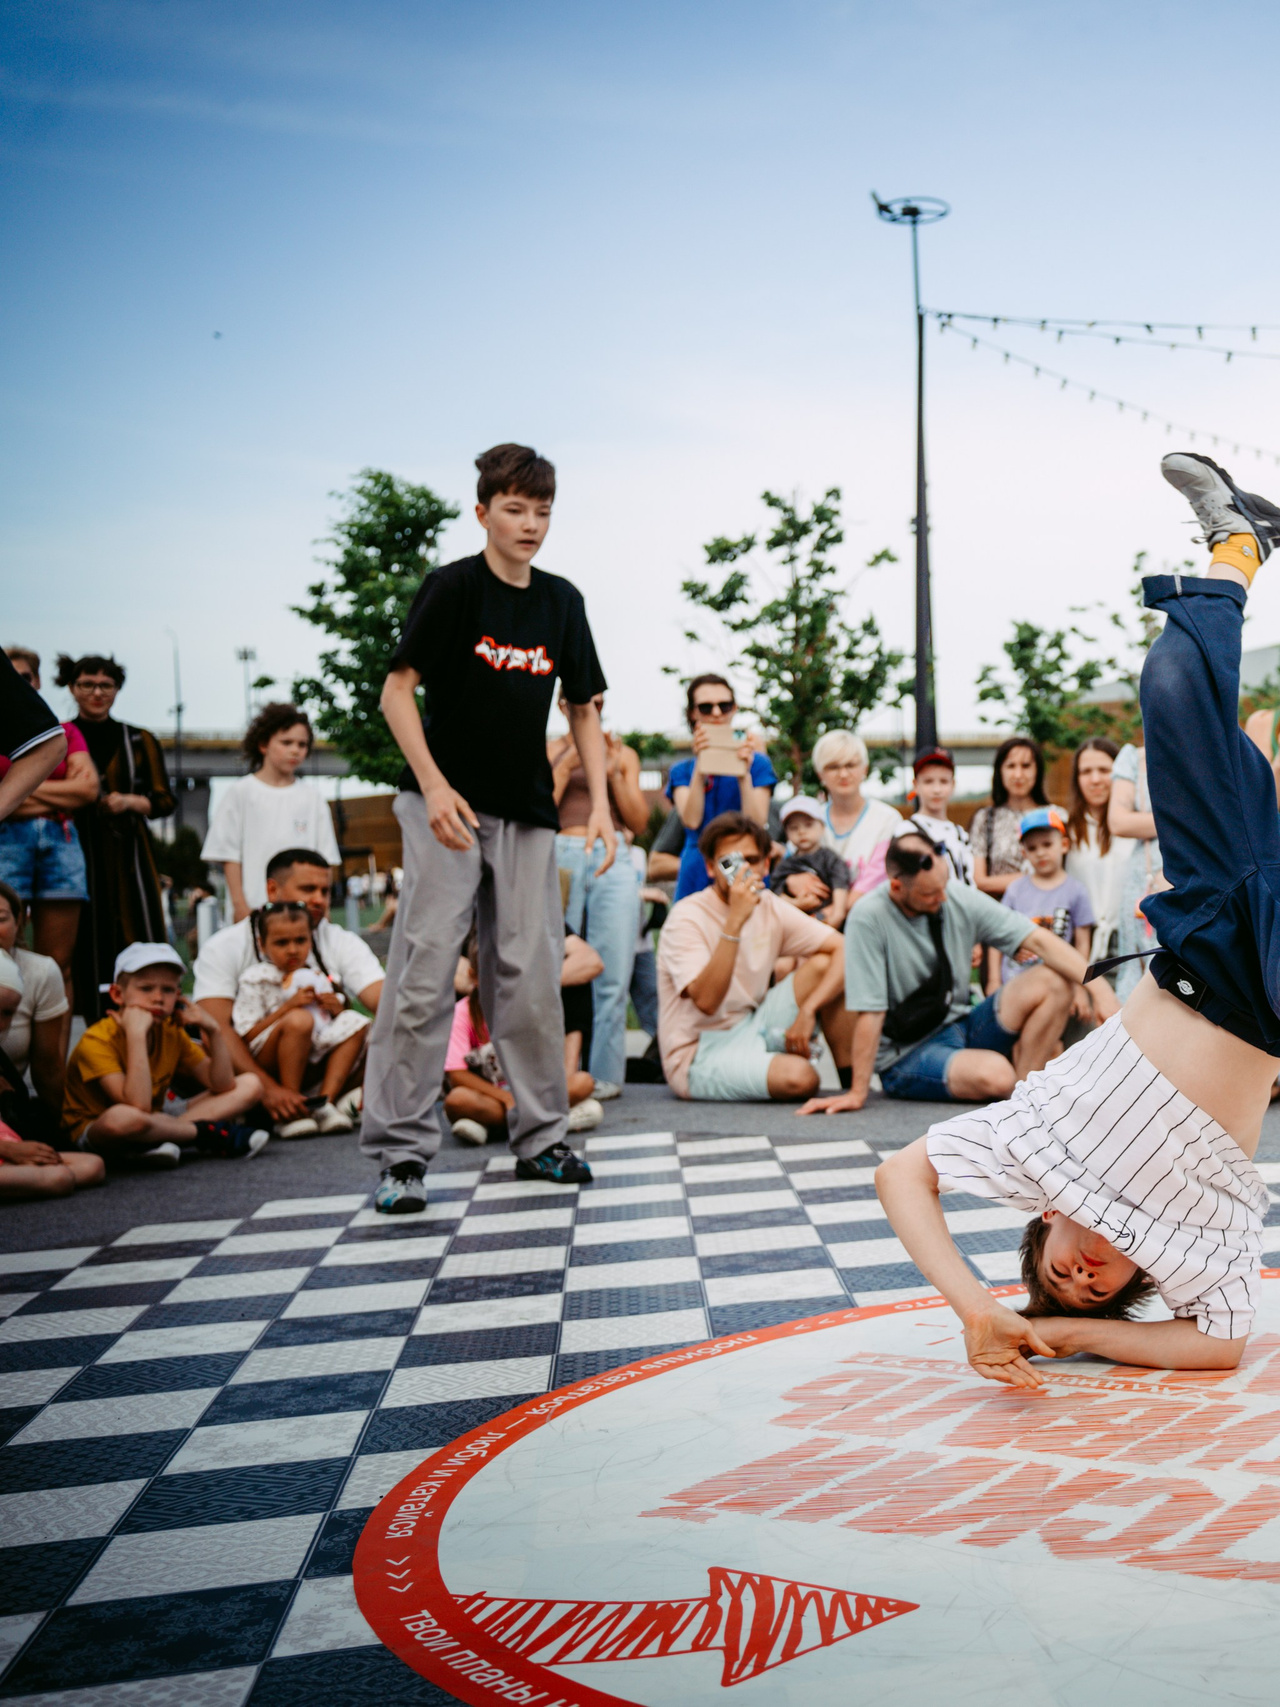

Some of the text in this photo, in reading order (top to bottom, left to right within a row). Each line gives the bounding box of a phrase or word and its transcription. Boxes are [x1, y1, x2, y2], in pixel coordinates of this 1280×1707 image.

[640, 1333, 758, 1371] любишь
[525, 1370, 642, 1416] кататься
[441, 1431, 507, 1469] люби
[428, 1469, 458, 1483] и
[384, 1481, 446, 1539] катайся
[439, 1649, 550, 1706] планы
